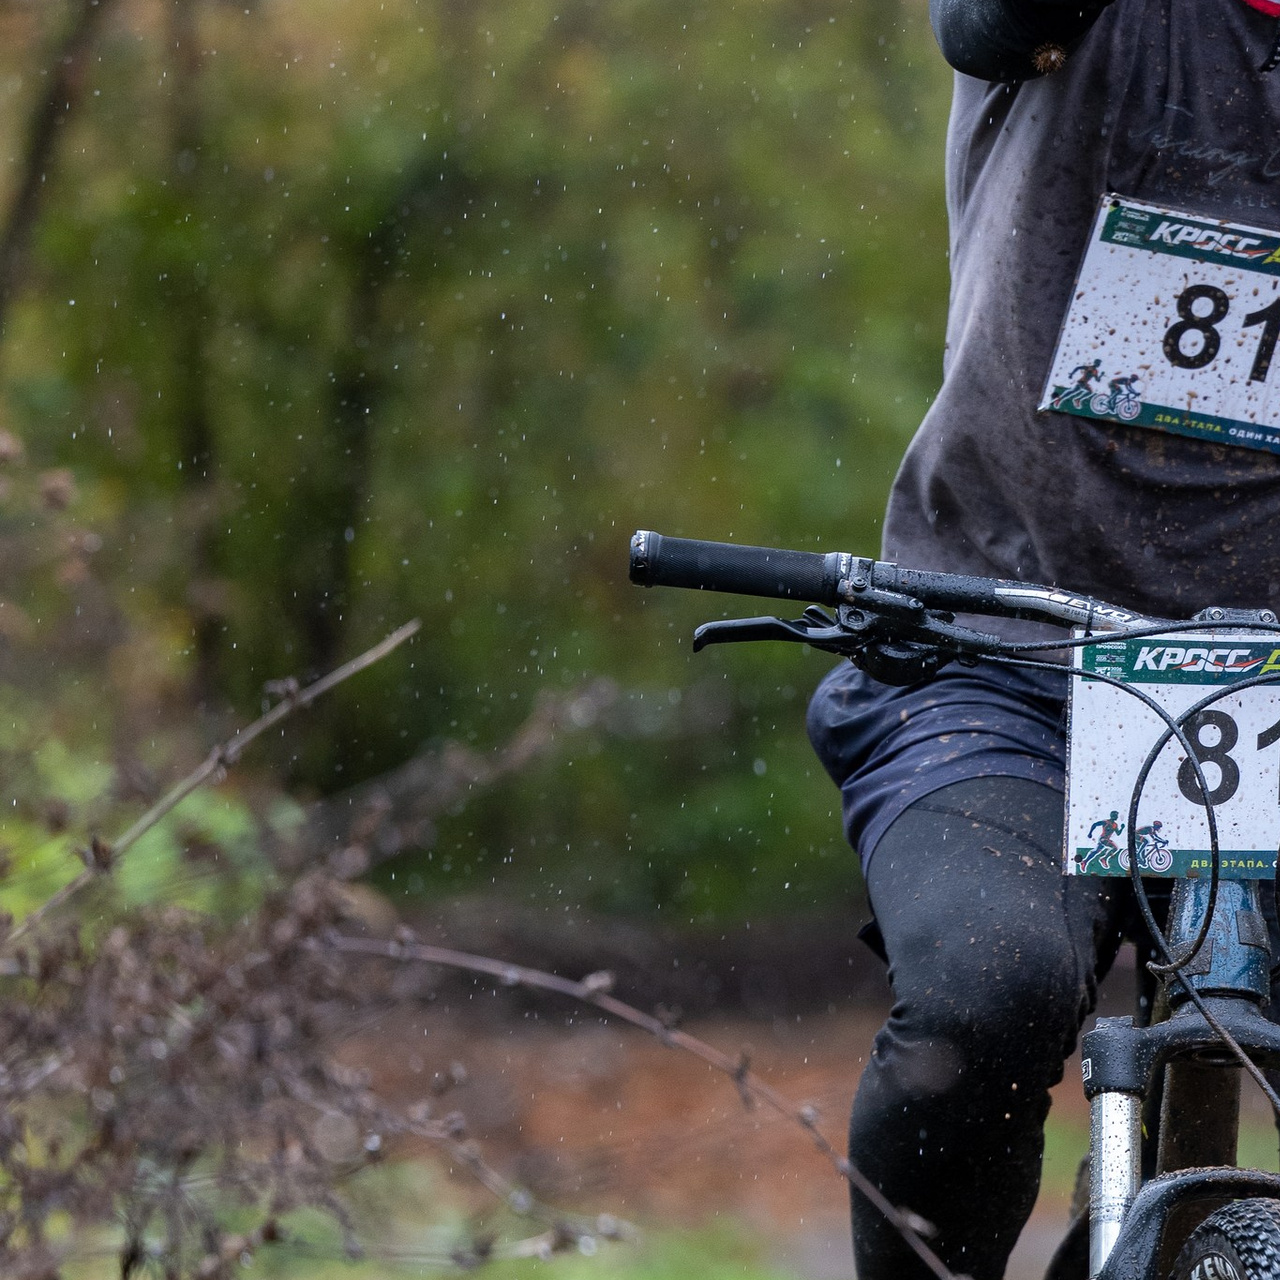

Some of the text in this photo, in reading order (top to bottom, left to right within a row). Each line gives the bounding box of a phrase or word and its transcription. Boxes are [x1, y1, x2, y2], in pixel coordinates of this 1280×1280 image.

[1150, 221, 1270, 259] КРОСС
[1154, 413, 1180, 426] ДВА
[1228, 427, 1263, 442] ОДИН
[1133, 646, 1267, 674] КРОСС
[1221, 859, 1269, 869] ЭТАПА.
